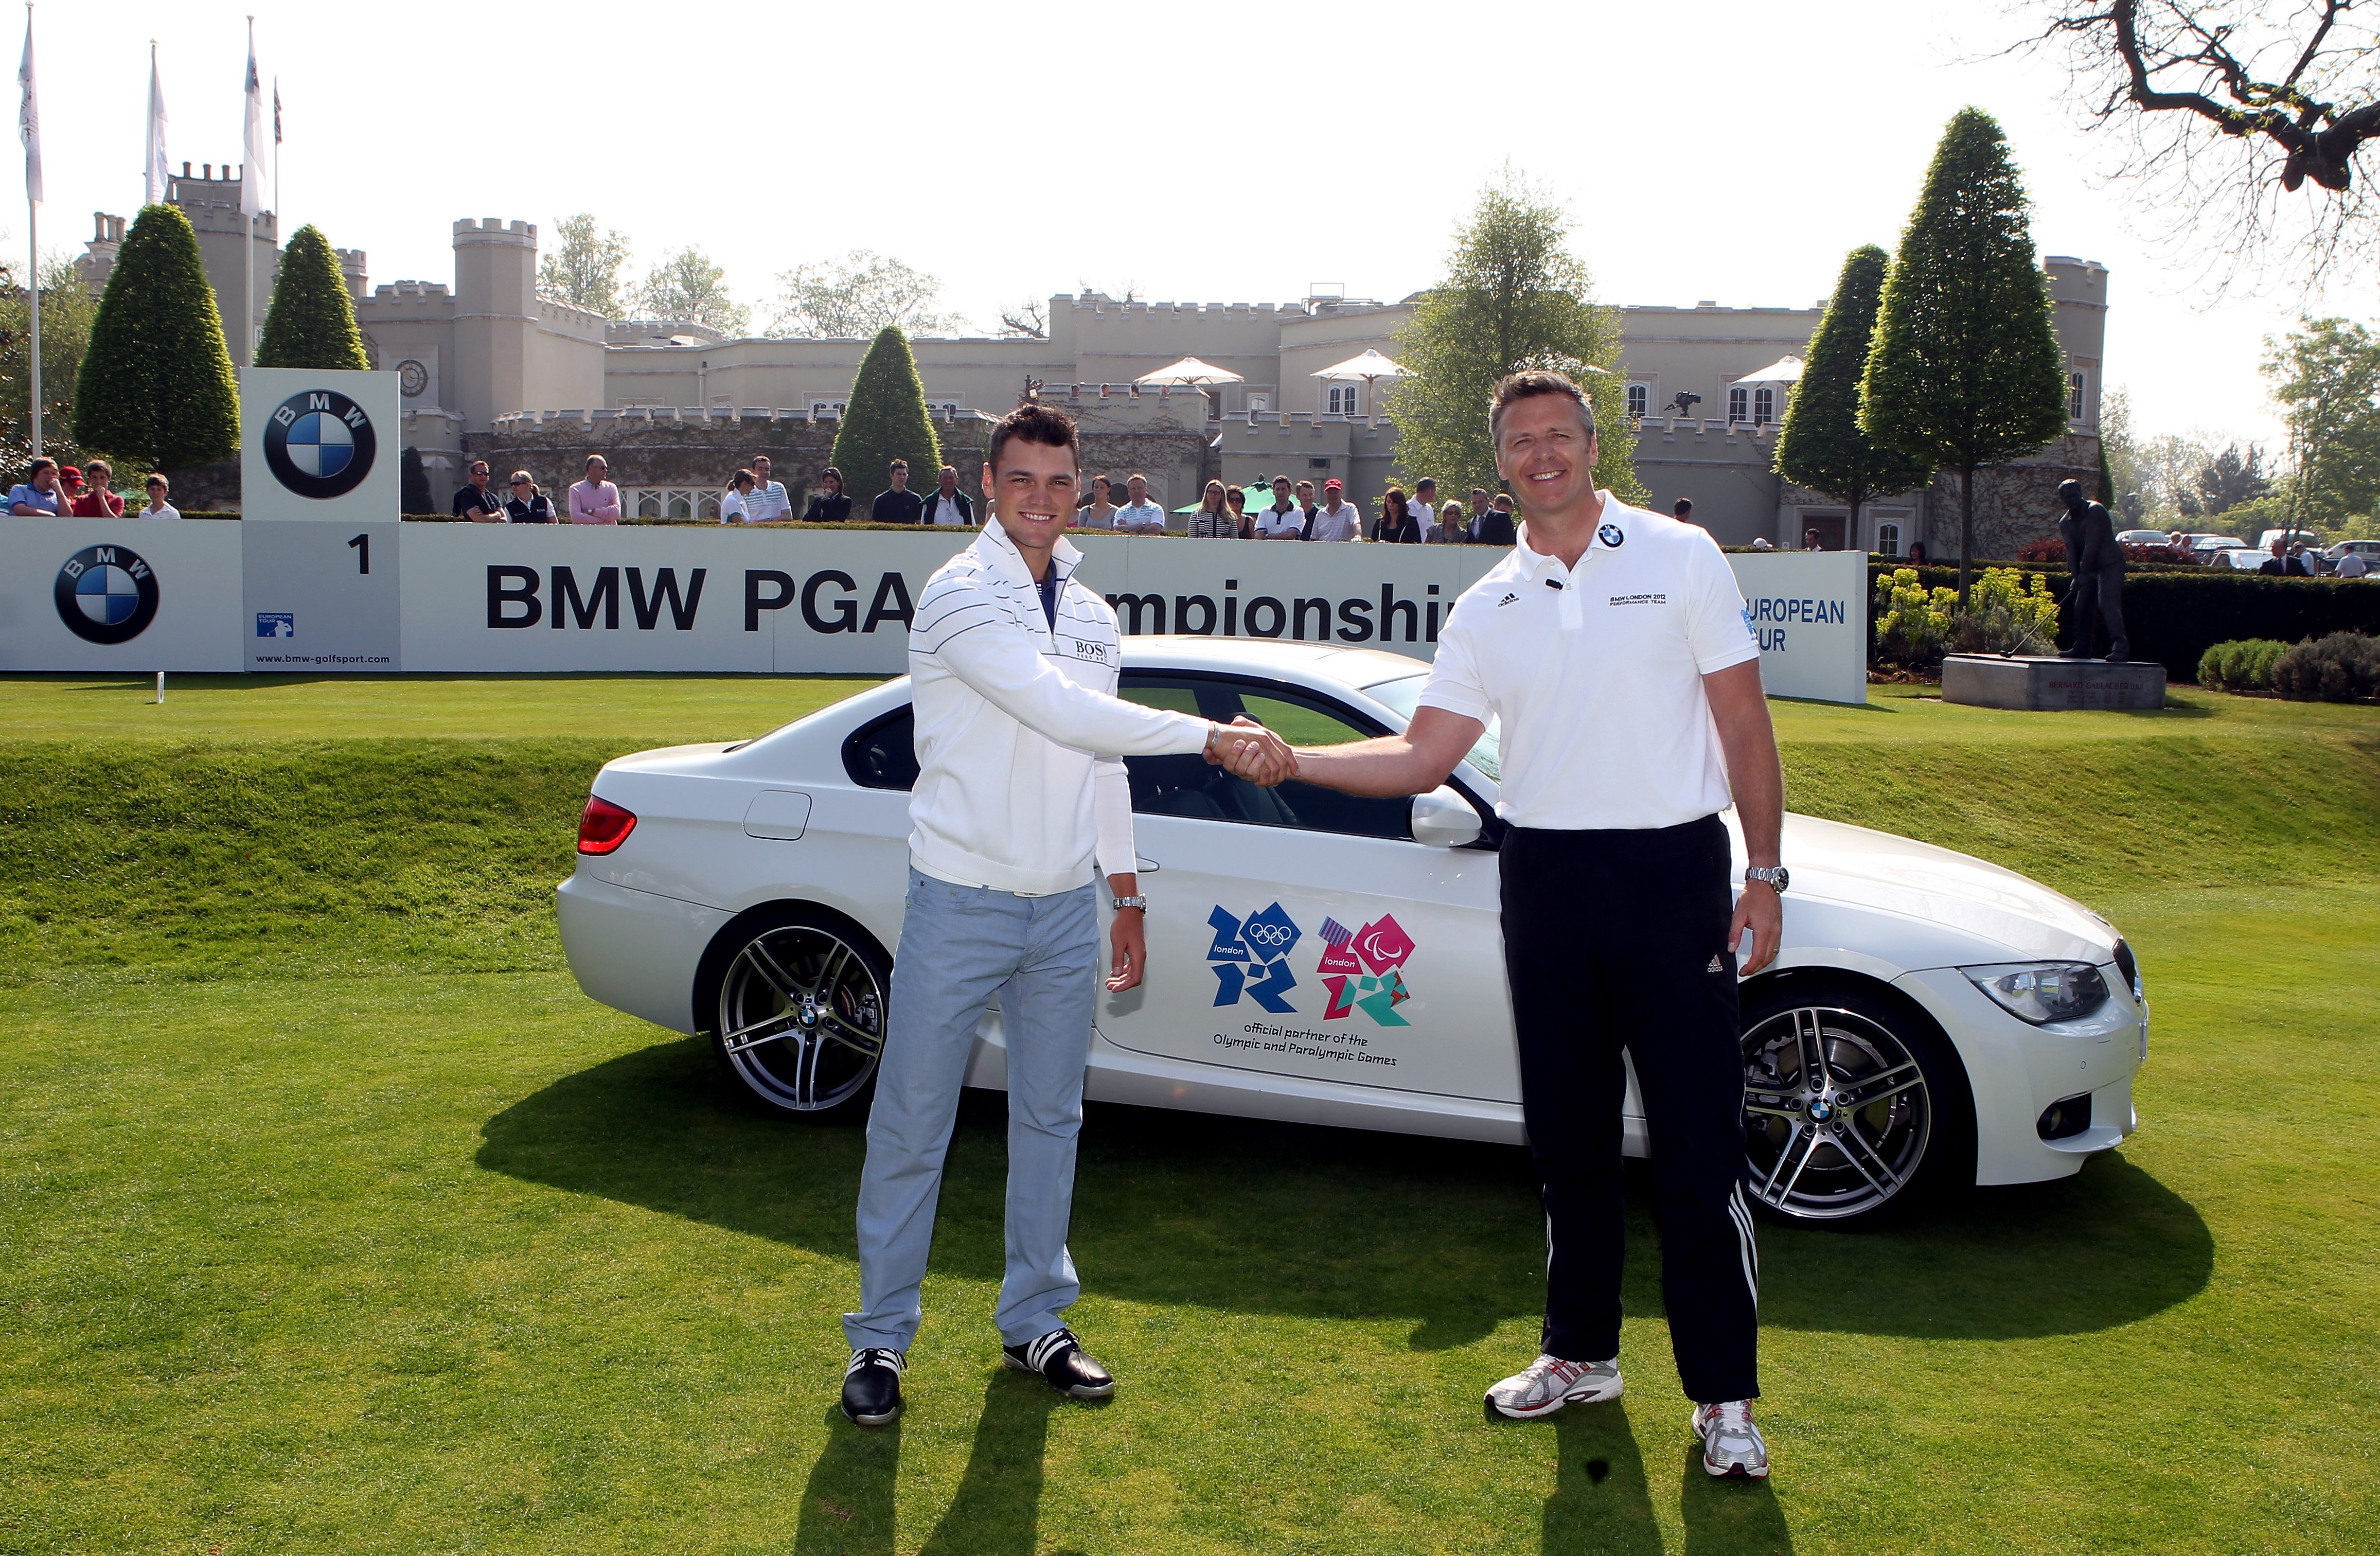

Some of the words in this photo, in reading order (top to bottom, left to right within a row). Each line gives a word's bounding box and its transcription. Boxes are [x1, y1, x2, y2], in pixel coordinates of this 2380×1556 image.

[274, 393, 367, 429] BMW
[64, 547, 150, 579] BMW
[347, 534, 369, 574] 1
[486, 565, 707, 631] BMW
[744, 569, 916, 634] PGA
[256, 655, 390, 664] www.bmw-golfsport.com
[2049, 681, 2083, 689] BERNARD
[1214, 945, 1244, 955] london
[1324, 957, 1355, 968] london
[1244, 1022, 1283, 1036] official
[1284, 1029, 1330, 1042] partner
[1333, 1033, 1347, 1044] of
[1349, 1034, 1368, 1047] the
[1213, 1034, 1260, 1050] Olympic
[1264, 1041, 1287, 1052] and
[1288, 1042, 1355, 1062] Paralympic
[1357, 1051, 1397, 1067] Games
